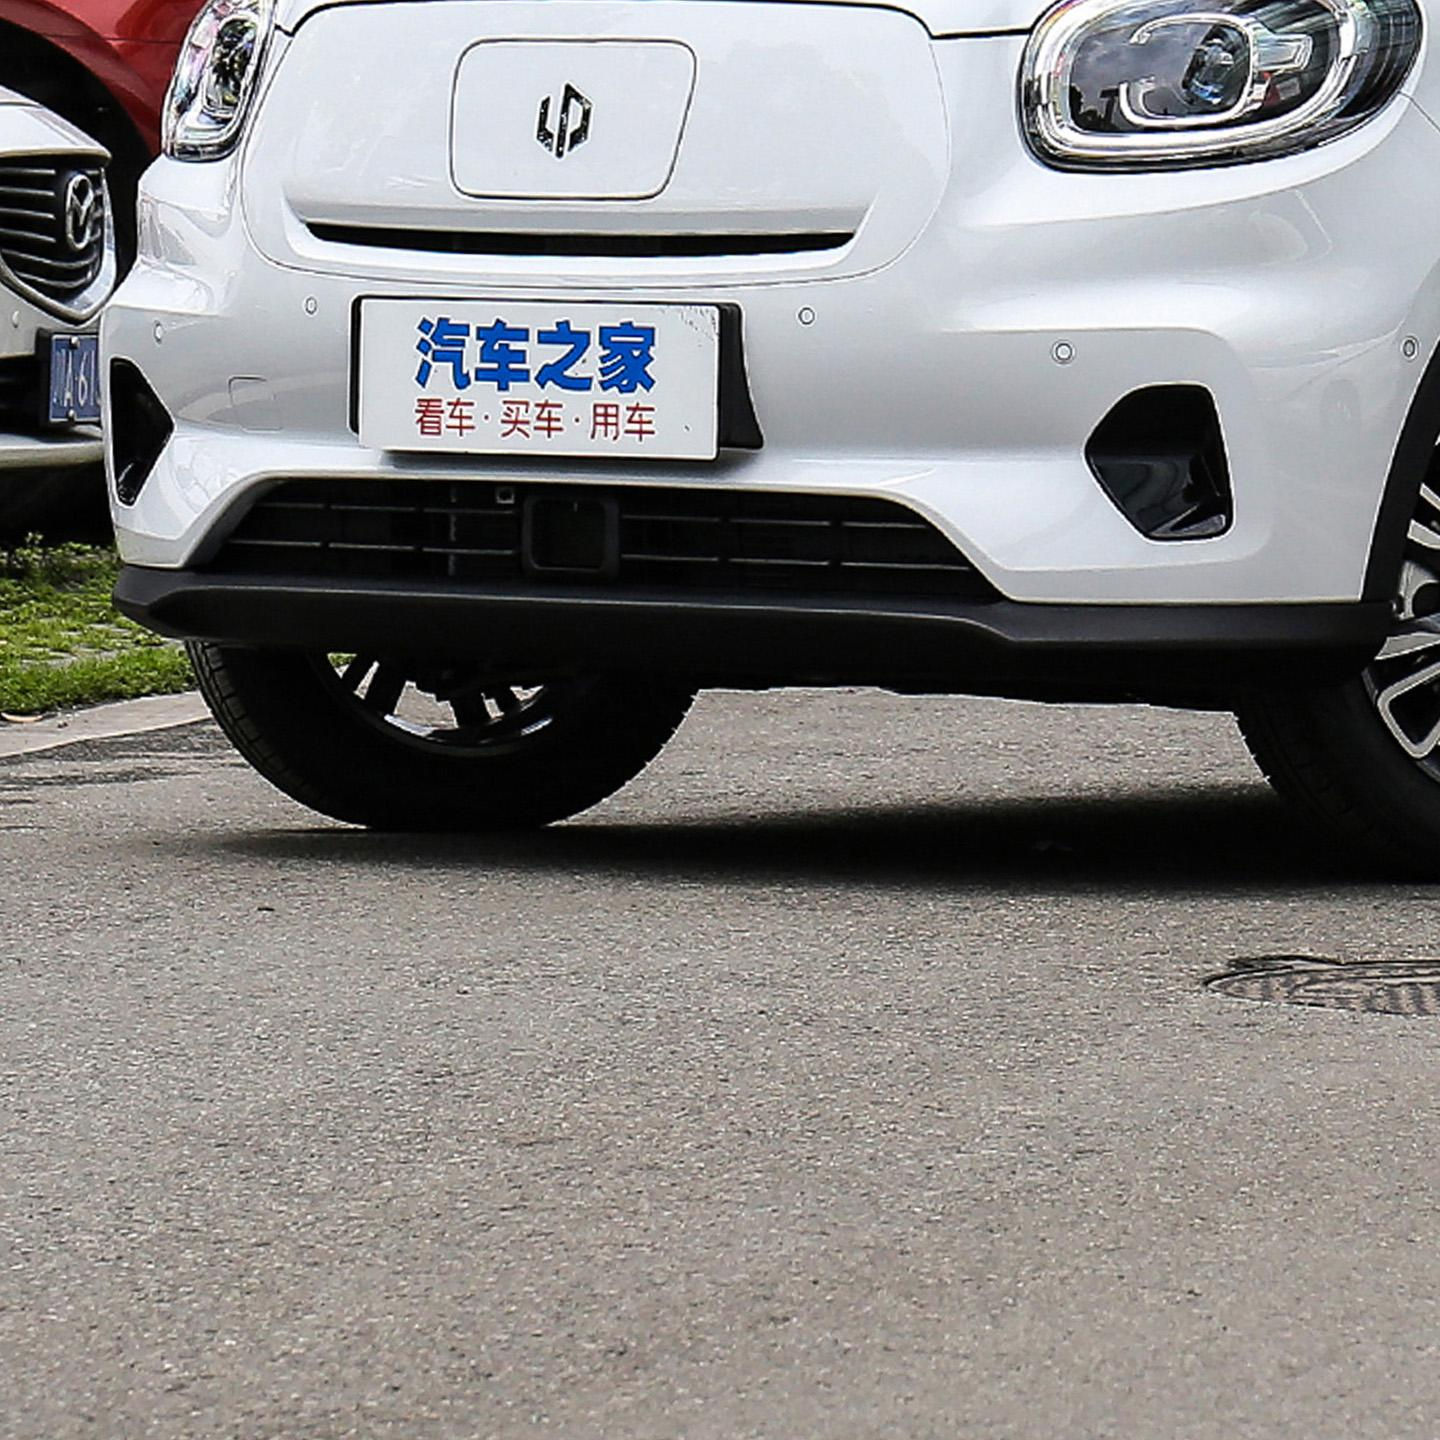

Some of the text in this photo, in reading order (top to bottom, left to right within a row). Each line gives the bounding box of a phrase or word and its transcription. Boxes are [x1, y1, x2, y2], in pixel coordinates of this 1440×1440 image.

[415, 317, 656, 394] 汽车之家
[415, 397, 656, 442] 看车·买车·用车
